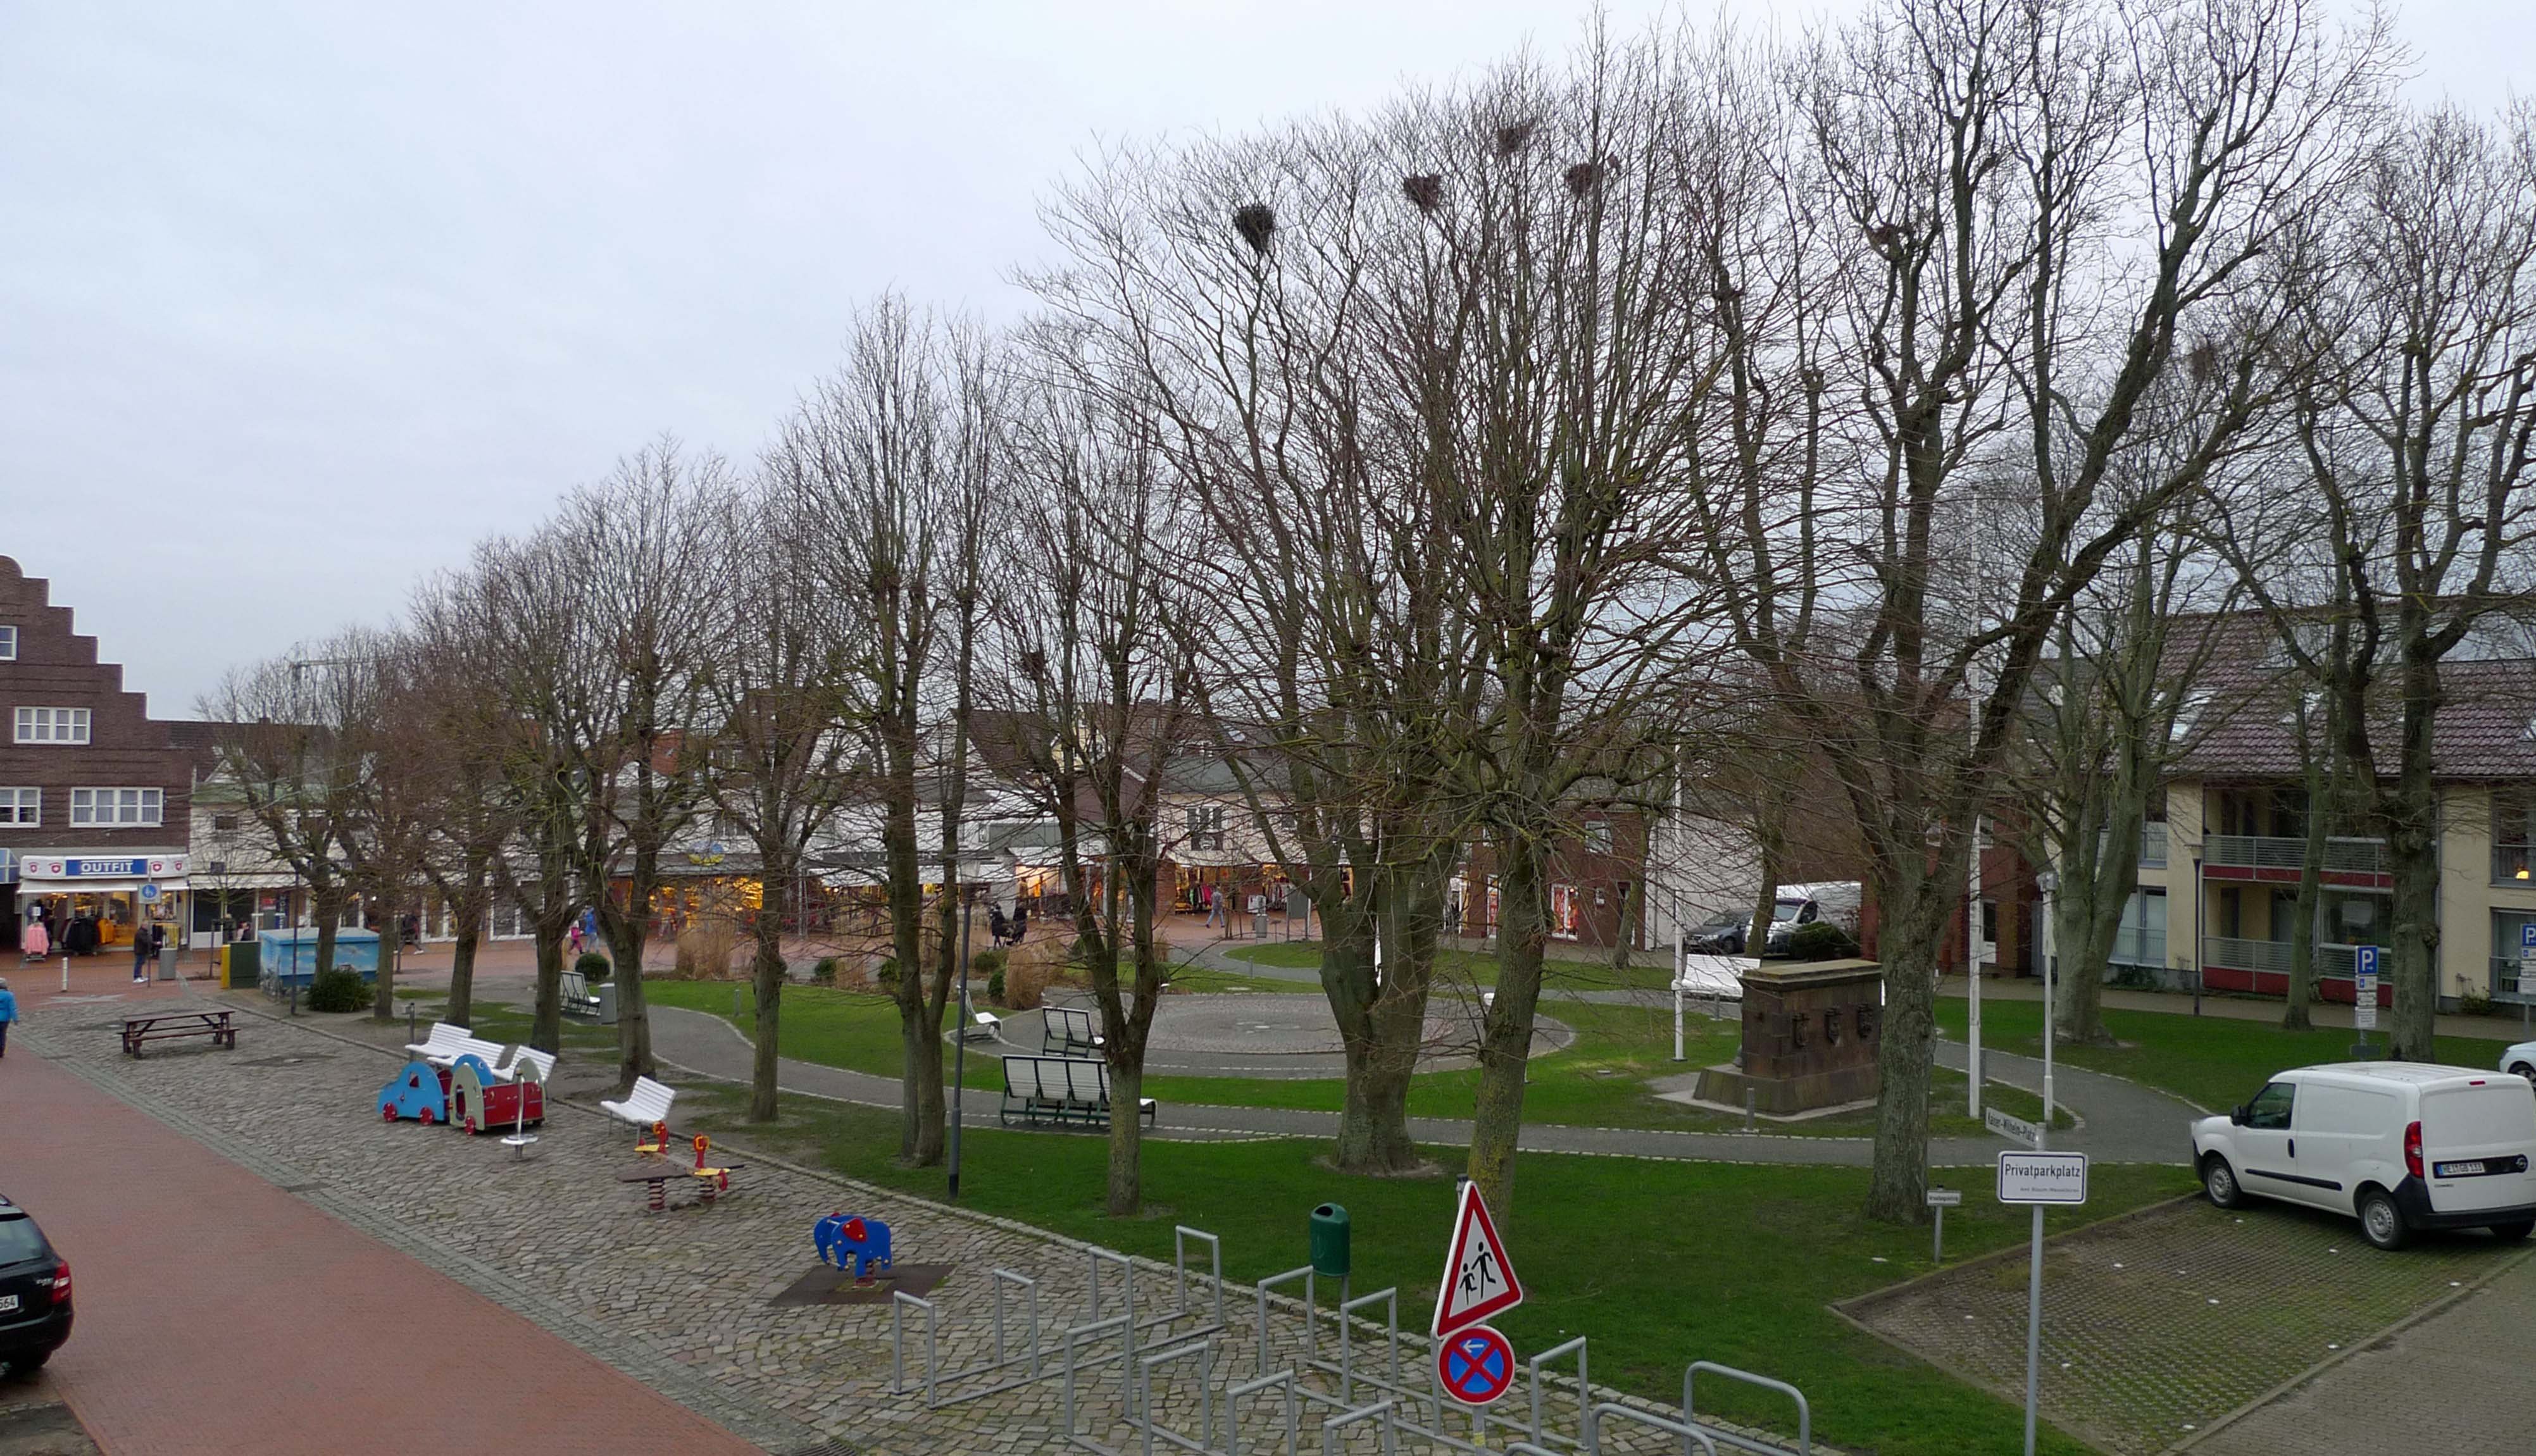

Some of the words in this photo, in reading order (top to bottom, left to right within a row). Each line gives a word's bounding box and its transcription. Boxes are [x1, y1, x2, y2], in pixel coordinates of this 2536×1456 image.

[81, 862, 133, 872] OUTFIT
[2525, 927, 2535, 944] P
[2361, 950, 2373, 971] P
[2005, 1164, 2080, 1179] Privatparkplatz
